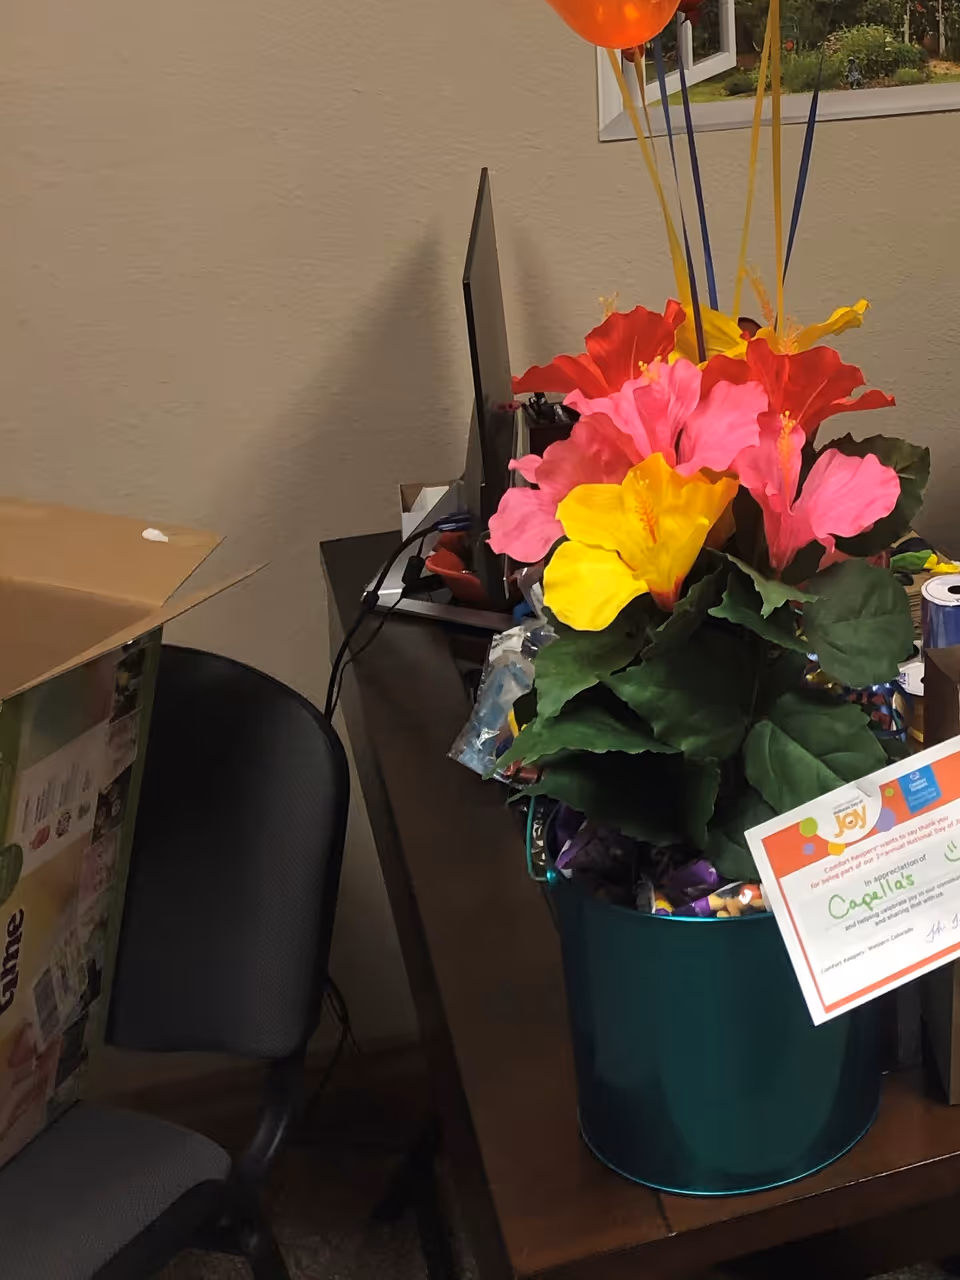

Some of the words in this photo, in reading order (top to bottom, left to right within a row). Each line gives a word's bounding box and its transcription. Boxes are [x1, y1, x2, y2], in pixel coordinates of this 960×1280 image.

[917, 820, 936, 831] thank
[936, 815, 949, 824] you
[863, 878, 872, 886] In
[872, 858, 920, 882] appreciation
[918, 854, 927, 862] of
[828, 871, 915, 919] Capella's
